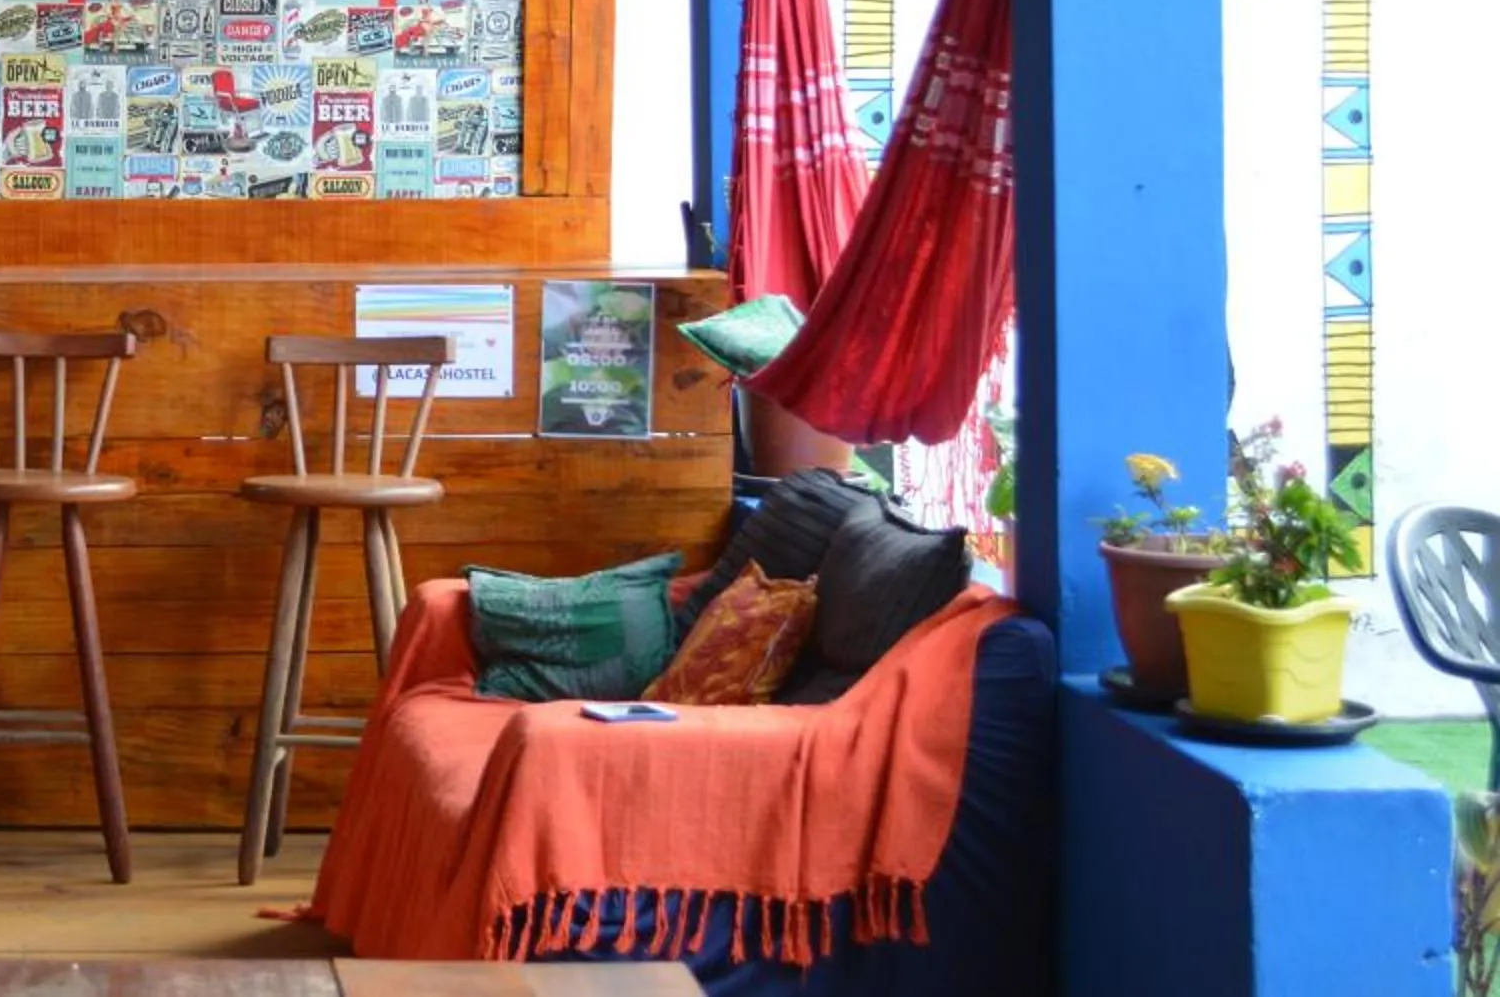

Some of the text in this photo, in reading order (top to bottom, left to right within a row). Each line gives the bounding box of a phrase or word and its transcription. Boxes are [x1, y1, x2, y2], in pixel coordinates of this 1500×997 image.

[226, 24, 271, 36] DANGER
[220, 53, 274, 63] VOLTAGE
[6, 64, 38, 82] OPEN
[317, 68, 349, 86] OPEN
[8, 100, 59, 117] BEER
[318, 104, 370, 121] BEER
[12, 176, 52, 189] SALOON
[323, 180, 362, 194] SALOON
